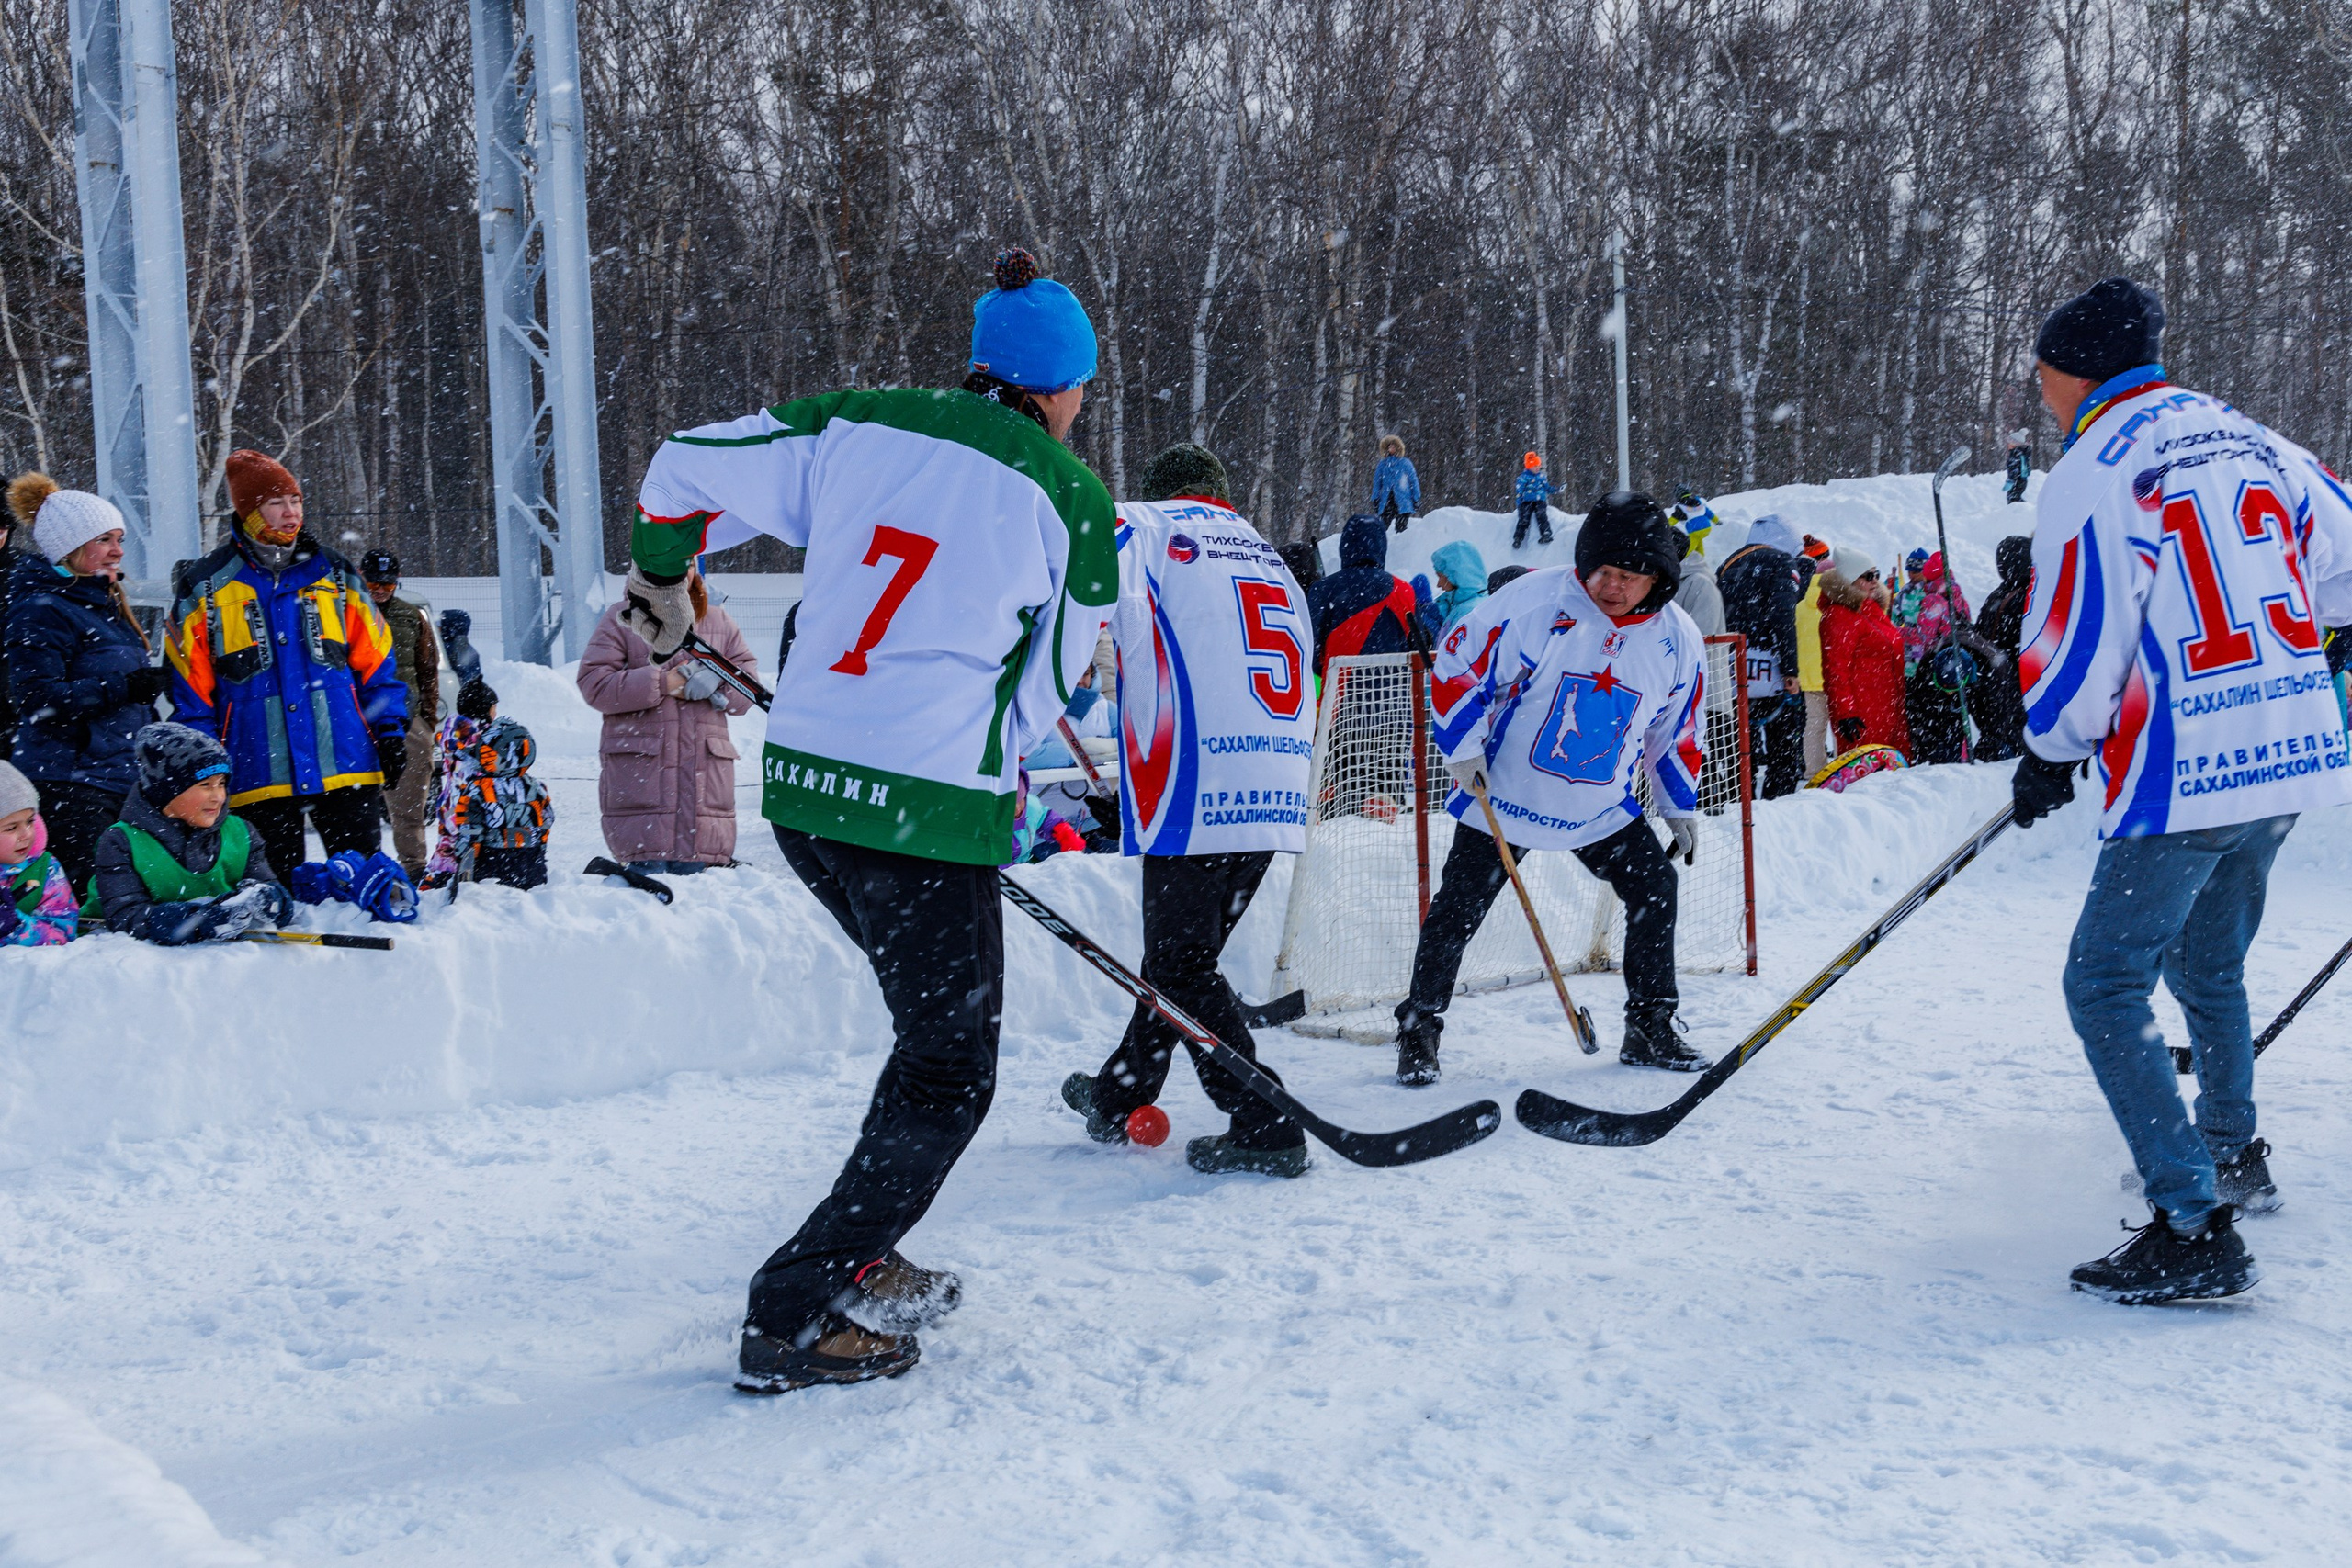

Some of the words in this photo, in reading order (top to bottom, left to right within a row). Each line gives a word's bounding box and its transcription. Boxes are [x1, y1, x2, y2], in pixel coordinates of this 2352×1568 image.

[828, 525, 940, 676] 7
[2159, 479, 2324, 682] 13
[1231, 575, 1305, 722] 5
[765, 757, 889, 807] САХАЛИН
[1202, 807, 1299, 826] САХАЛИНСКОЙ
[2179, 753, 2321, 797] САХАЛИНСКОЙ
